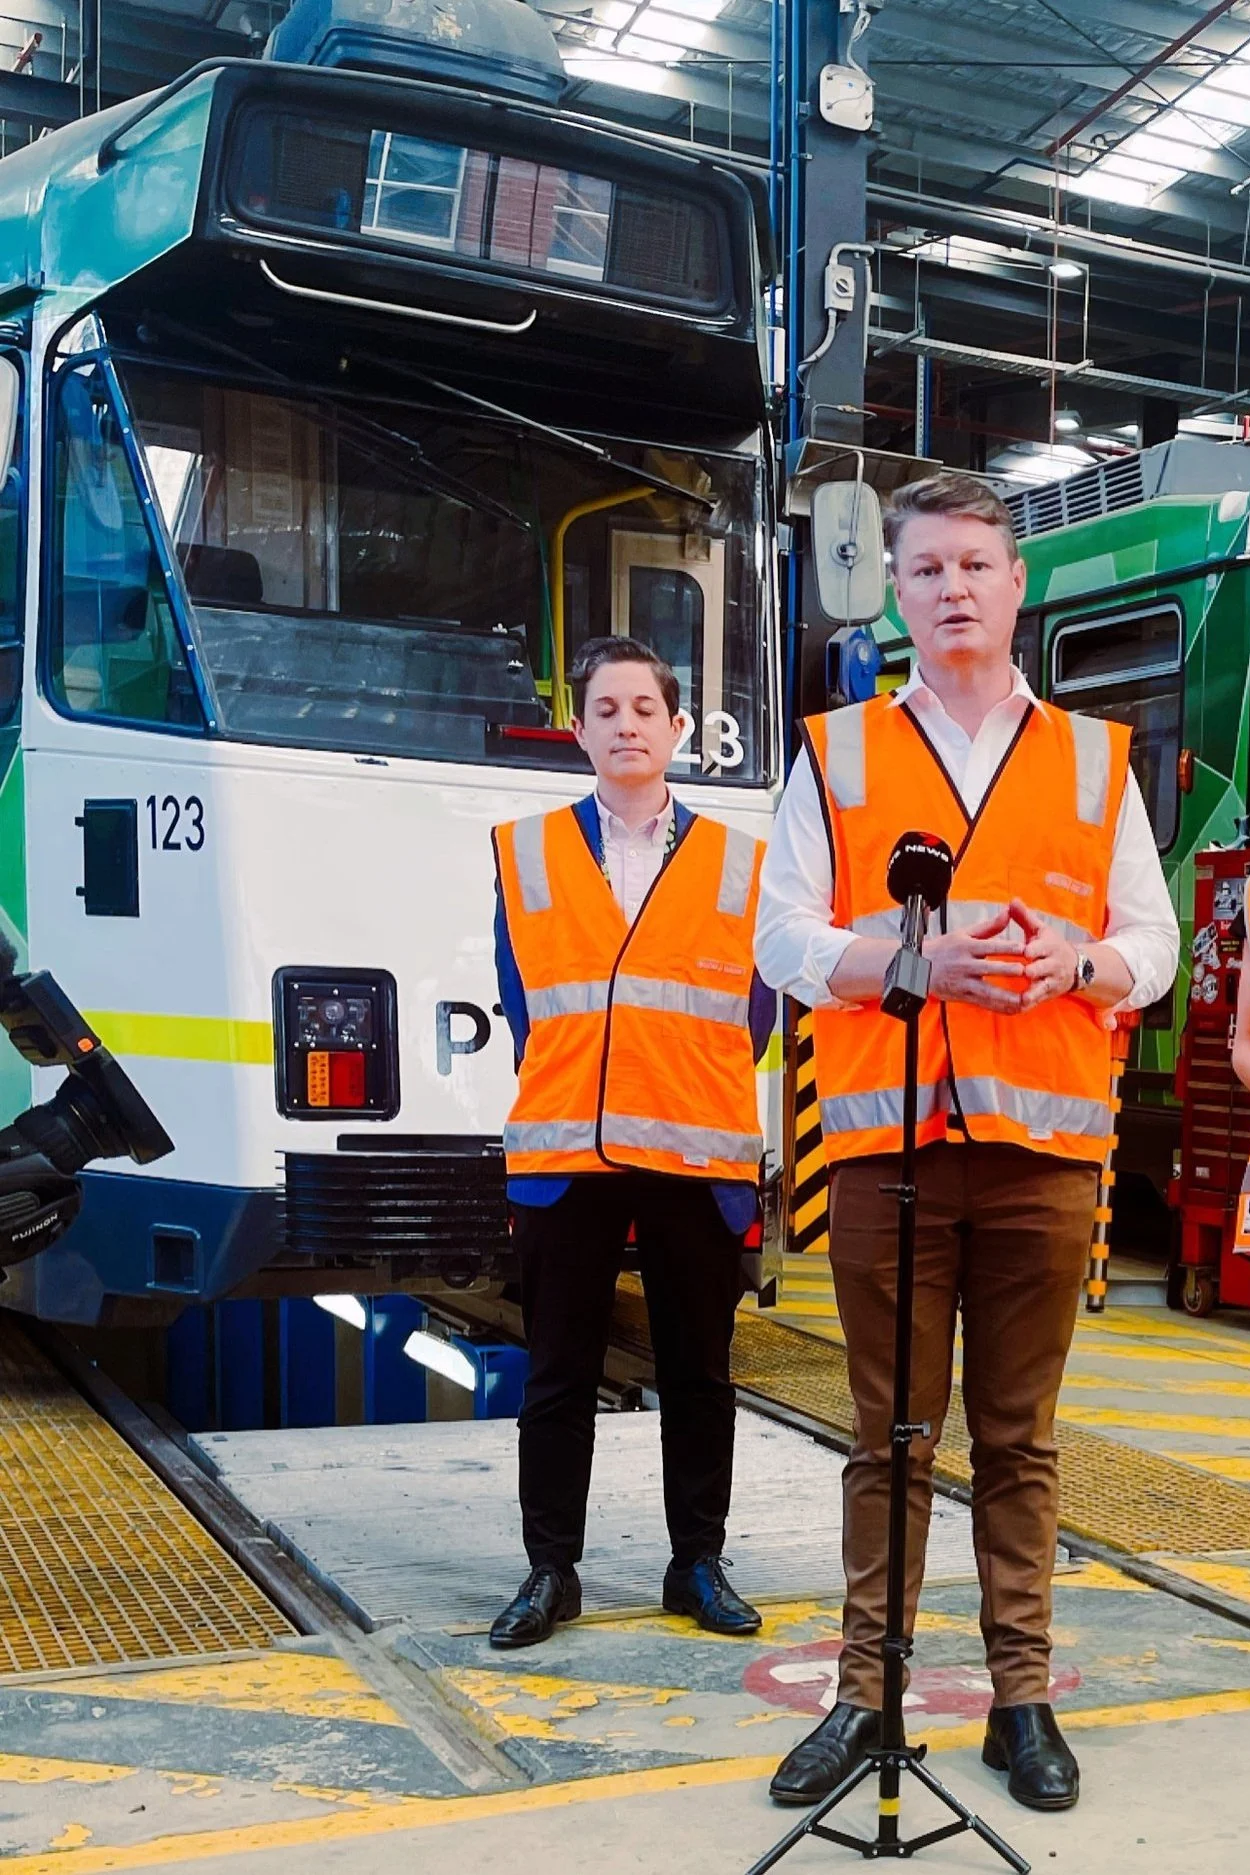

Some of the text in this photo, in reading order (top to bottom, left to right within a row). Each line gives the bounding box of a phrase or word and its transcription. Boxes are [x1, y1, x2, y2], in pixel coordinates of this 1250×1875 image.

[146, 795, 205, 851] 123
[905, 844, 948, 862] NEWS
[436, 1000, 504, 1075] P
[12, 1212, 58, 1241] FUJINON
